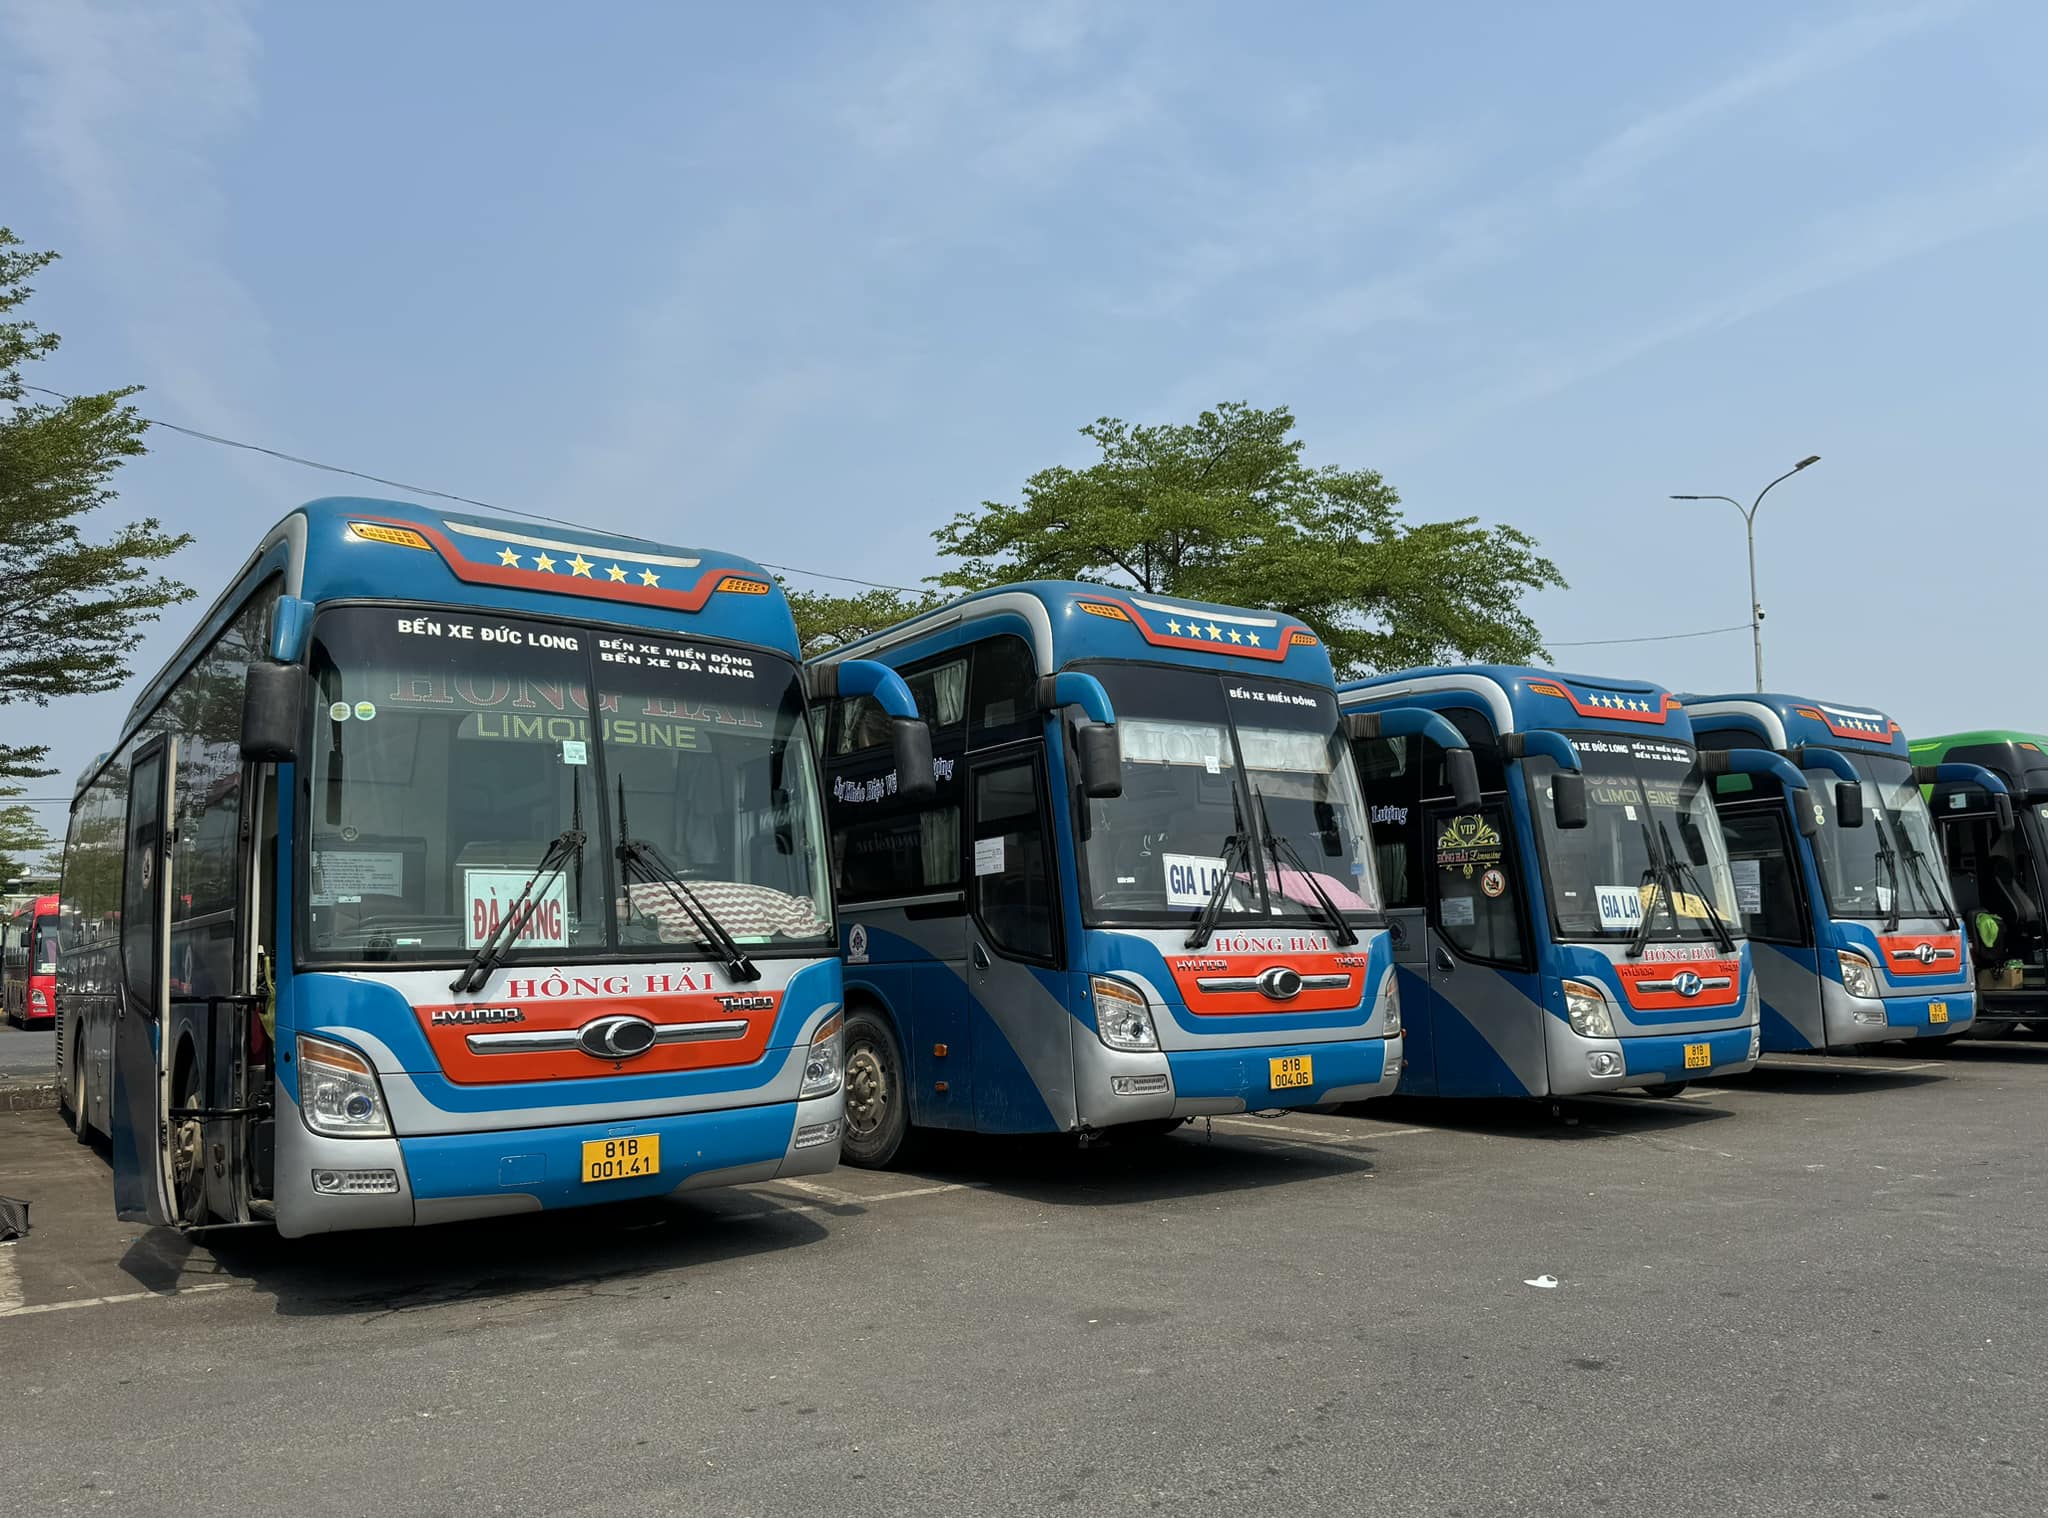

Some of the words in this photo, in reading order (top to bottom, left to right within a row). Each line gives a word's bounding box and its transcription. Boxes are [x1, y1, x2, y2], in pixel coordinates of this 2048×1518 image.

[398, 617, 441, 636] BẾN
[448, 624, 474, 639] XE
[481, 626, 522, 644] ĐỨC
[528, 633, 579, 651] LONG
[599, 638, 634, 651] BẾN
[639, 645, 661, 655] XE
[711, 653, 753, 666] ĐÔNG
[601, 651, 641, 665] BẾN
[647, 658, 671, 668] XE
[677, 660, 702, 672] ĐÀ
[1229, 687, 1250, 699] BẾN
[1252, 691, 1265, 702] XE
[1579, 742, 1592, 752] XE
[1608, 743, 1629, 754] LONG
[1460, 824, 1476, 835] VIP
[1170, 864, 1198, 896] GIA
[1601, 894, 1622, 918] GIA
[1623, 894, 1641, 918] LAI
[1215, 931, 1282, 953] HỒNG
[1175, 960, 1228, 972] HYUNDAI
[507, 967, 630, 998] HỒNG
[645, 966, 714, 993] HẢI
[1282, 1058, 1300, 1072] 81B
[1275, 1072, 1309, 1087] 004.06
[606, 1139, 638, 1158] 81B
[592, 1156, 649, 1178] 001.41
